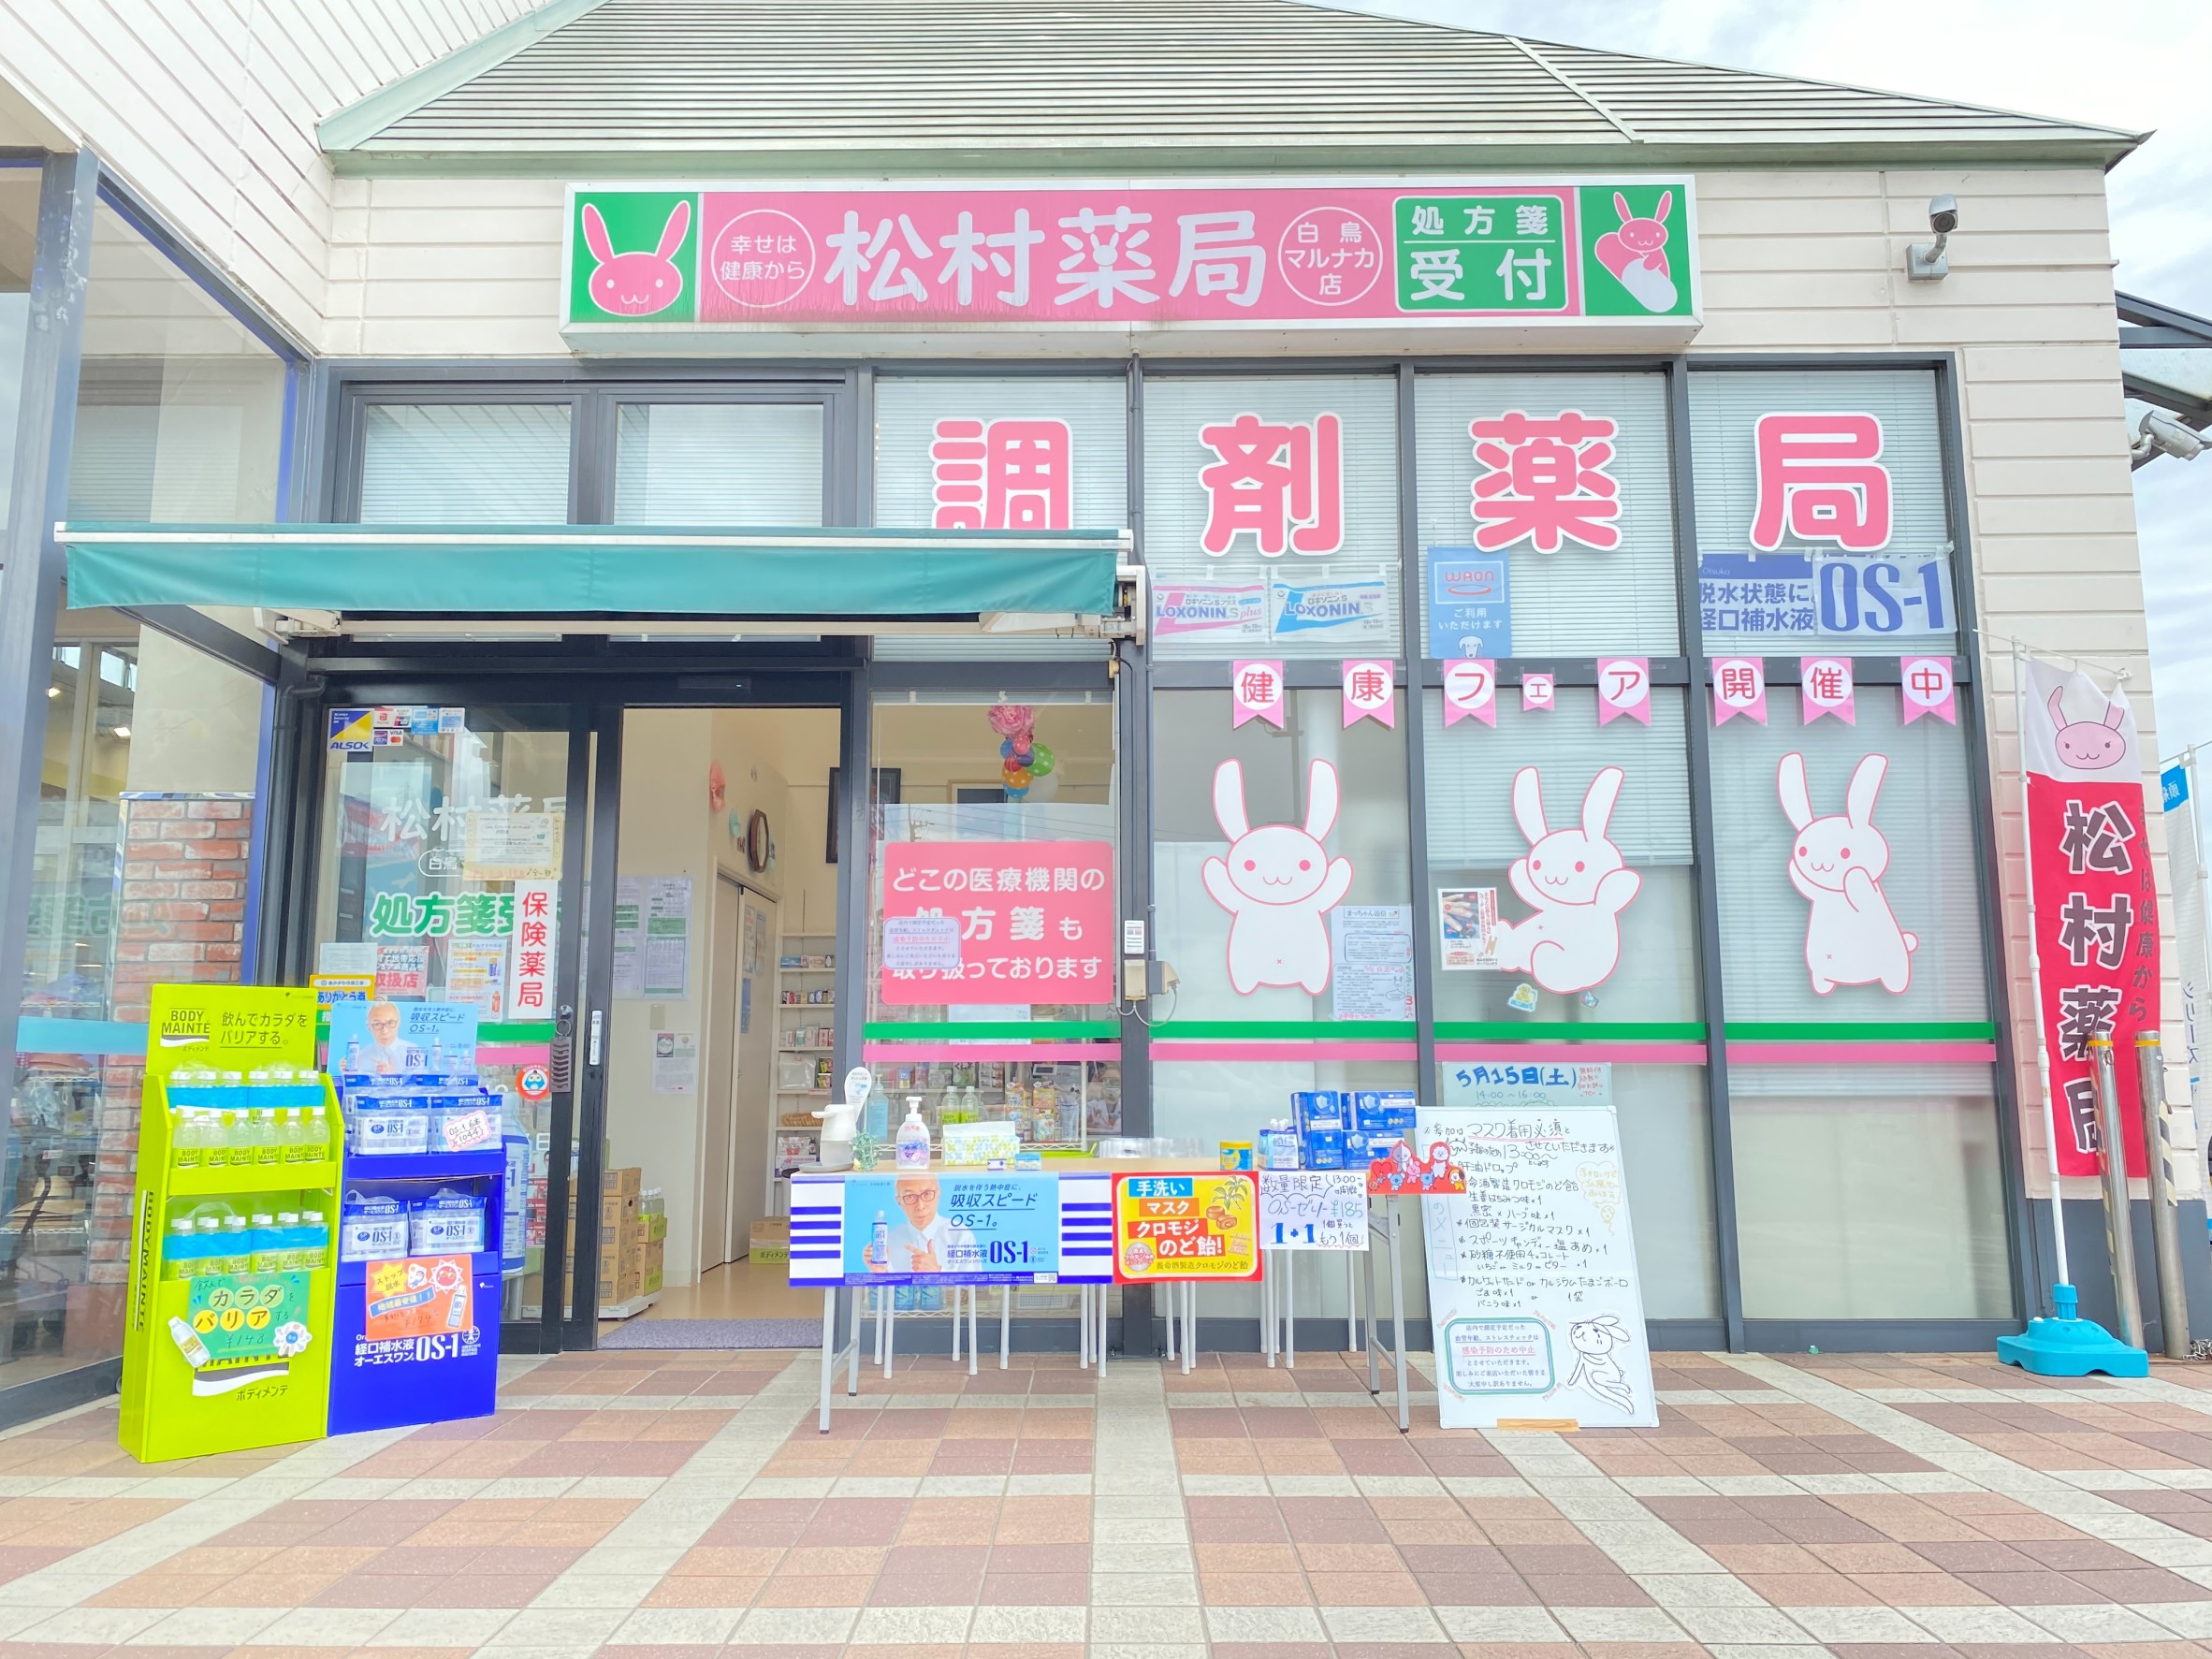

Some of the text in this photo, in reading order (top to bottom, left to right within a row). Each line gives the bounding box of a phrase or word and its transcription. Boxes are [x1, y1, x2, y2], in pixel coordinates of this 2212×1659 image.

[1410, 204, 1550, 236] 処方箋
[1297, 221, 1363, 244] 白鳥
[730, 234, 797, 255] 幸せは
[824, 205, 1268, 309] 松村薬局
[1285, 247, 1375, 269] マルナカ
[720, 259, 806, 282] 健康から
[1409, 247, 1552, 302] 受付
[1318, 274, 1343, 297] 店
[1445, 570, 1495, 582] WAON
[1702, 566, 1731, 576] Otsuka
[1819, 560, 1944, 633] OS-1
[1155, 605, 1227, 618] LOXONIN
[1285, 601, 1361, 618] LOXONIN
[1454, 607, 1488, 618] ご利用
[1438, 620, 1503, 631] いただけます
[329, 741, 370, 749] ALSOK
[892, 866, 1105, 893] どこの医療機関の
[517, 891, 548, 1008] 保険薬局
[170, 1010, 204, 1022] BODY
[221, 1011, 308, 1027] 飲んでカラダを
[410, 1012, 465, 1023] 吸収スピード
[1136, 1179, 1186, 1198] 手洗い
[1260, 1173, 1323, 1195] 数量限定
[950, 1192, 1039, 1209] 吸収スピード
[1146, 1200, 1190, 1215] マスク
[371, 1230, 392, 1243] OS-1
[445, 1225, 466, 1237] OS-1
[1136, 1219, 1200, 1239] クロモジ
[947, 1249, 988, 1259] 経口補水液
[989, 1240, 1028, 1264] OS-1
[355, 1338, 415, 1356] 経口補水液
[415, 1334, 458, 1362] OS-1
[1462, 1346, 1535, 1355] 感染予防のため中止
[354, 1351, 415, 1367] オーエスワン
[236, 1384, 289, 1402] ボディメンテ
